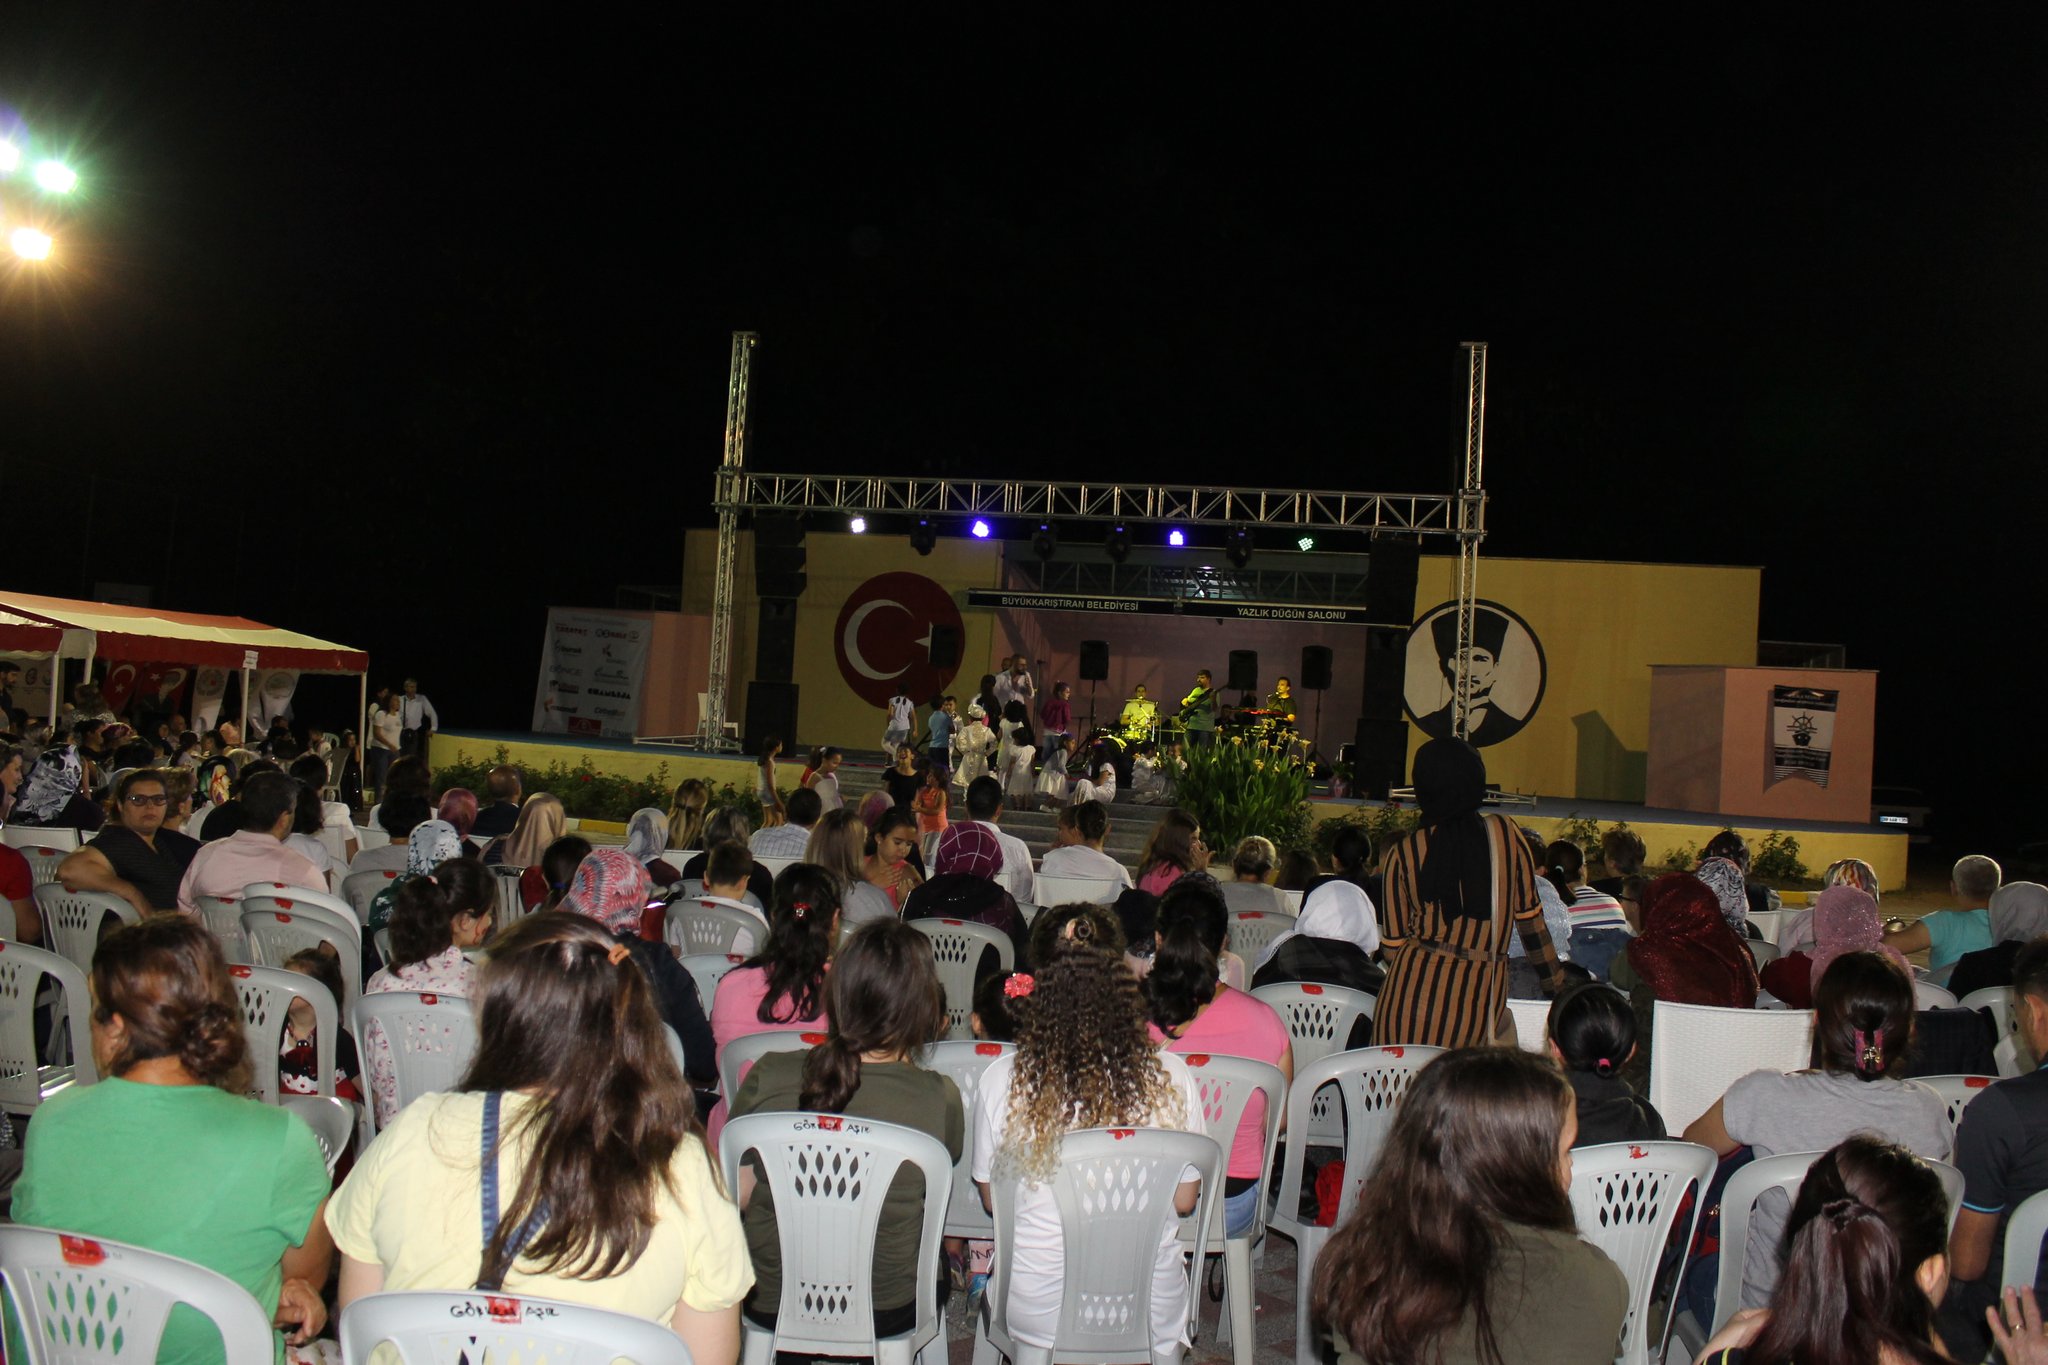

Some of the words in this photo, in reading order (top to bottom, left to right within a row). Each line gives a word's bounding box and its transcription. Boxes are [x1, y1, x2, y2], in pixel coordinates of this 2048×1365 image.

[1001, 596, 1085, 609] BÜYÜKKARIŞTIRAN
[1086, 600, 1139, 611] BELEDİYESİ
[1237, 606, 1270, 617] YAZLIK
[1271, 608, 1305, 619] DÜĞÜN
[1307, 610, 1347, 620] SALONU
